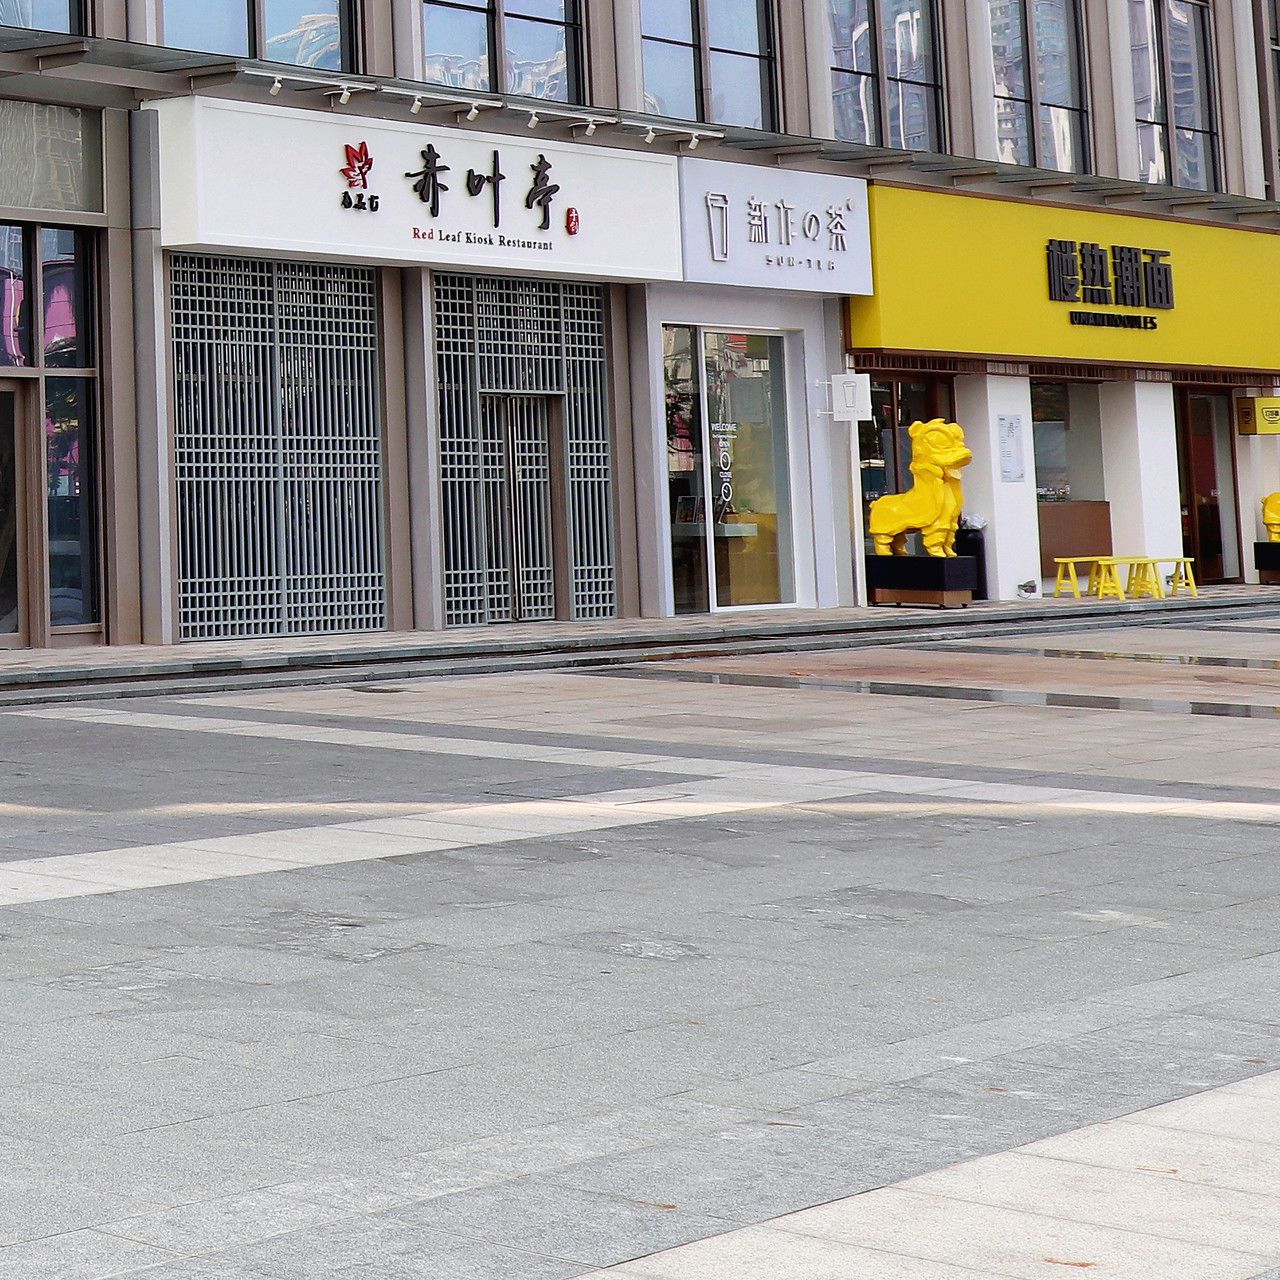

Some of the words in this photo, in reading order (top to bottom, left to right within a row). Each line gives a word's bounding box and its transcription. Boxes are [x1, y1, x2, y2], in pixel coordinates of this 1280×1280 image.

[404, 143, 560, 230] 赤叶亭
[412, 227, 434, 240] Red
[438, 230, 461, 243] Leaf
[465, 232, 494, 246] Kiosk
[498, 236, 553, 250] Restaurant
